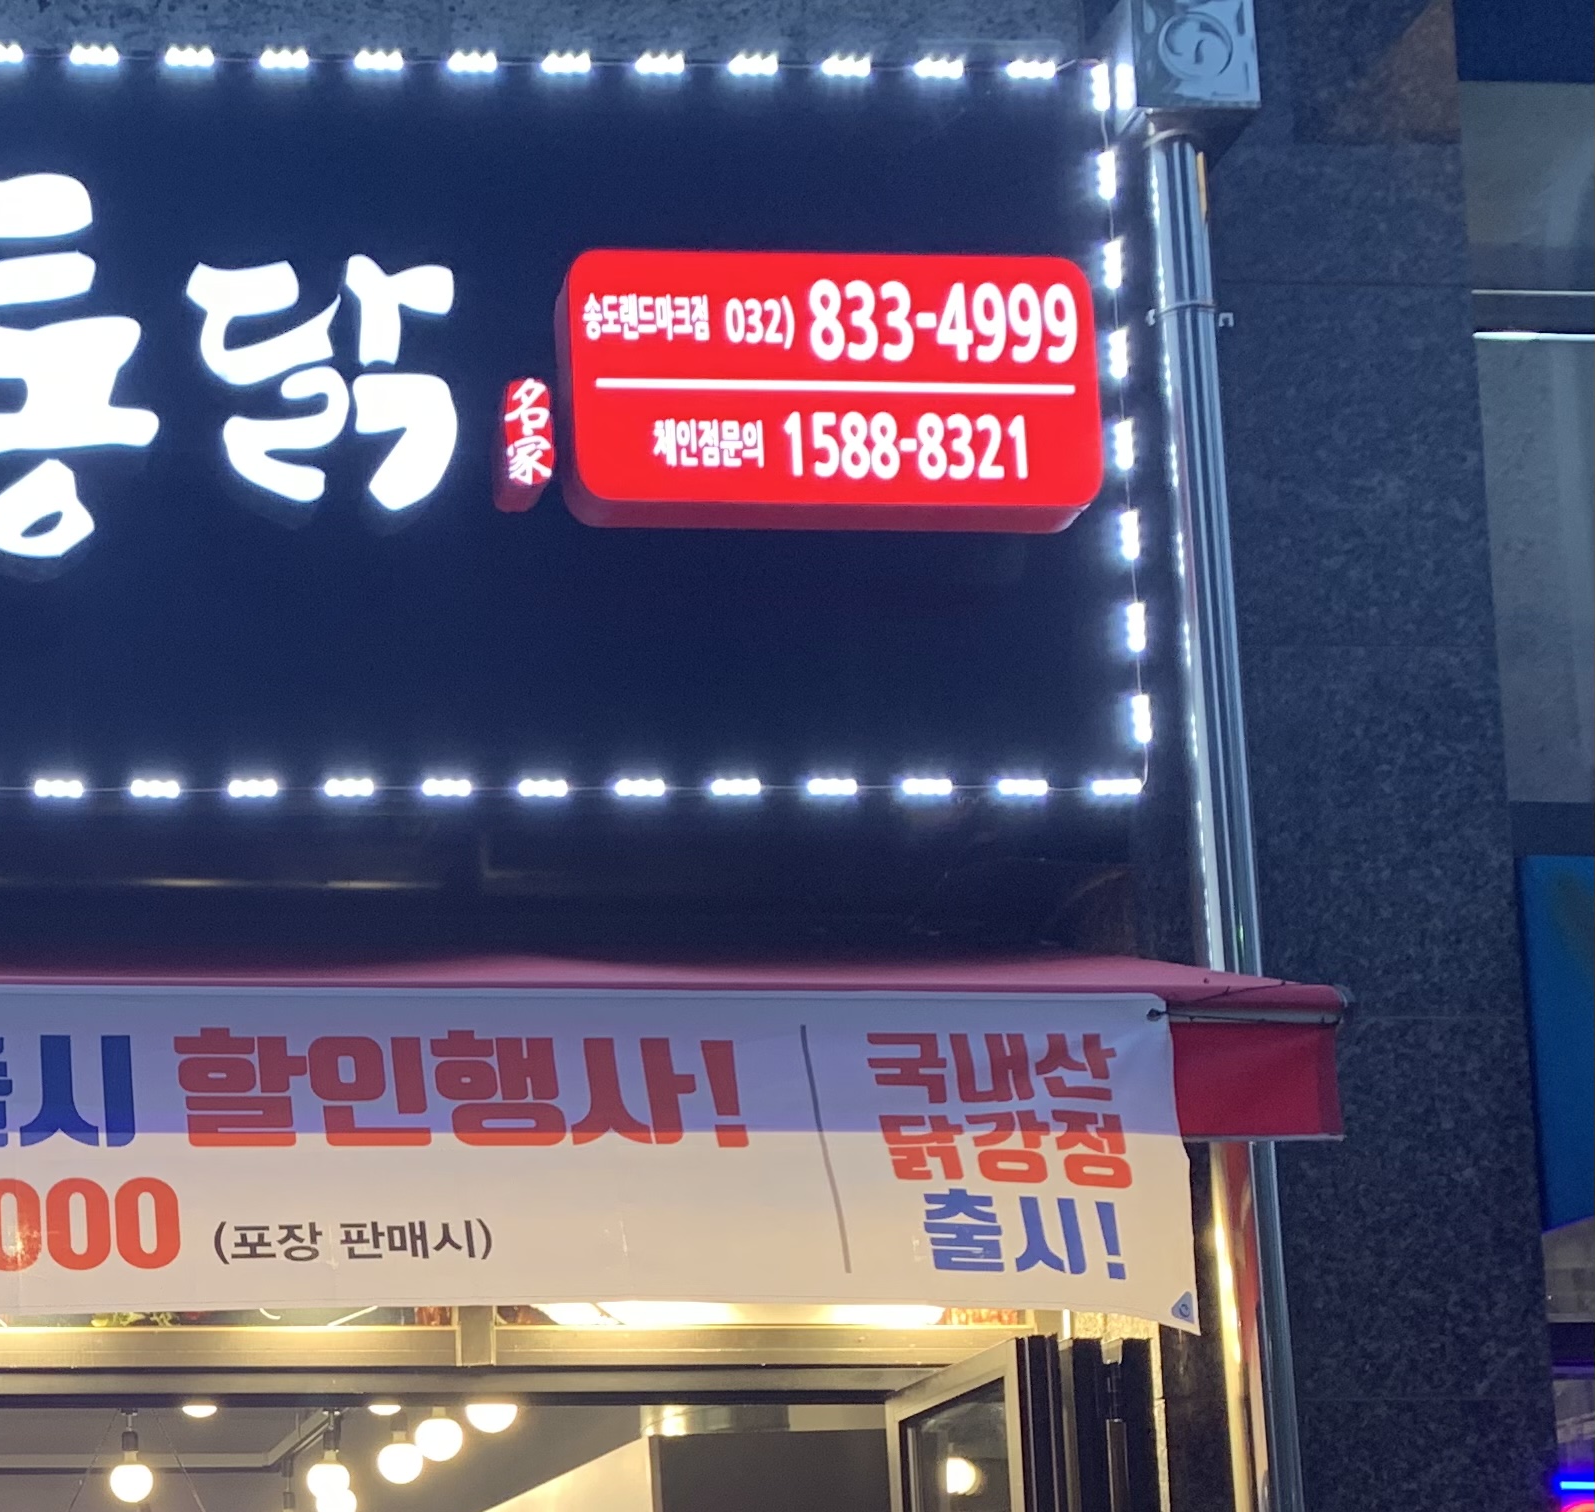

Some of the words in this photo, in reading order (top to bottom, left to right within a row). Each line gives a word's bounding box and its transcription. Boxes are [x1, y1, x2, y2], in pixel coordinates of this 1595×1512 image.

[725, 295, 795, 350] 032)
[809, 278, 1078, 365] 833-4999
[652, 417, 765, 469] 체인점문의
[784, 410, 1029, 481] 1588-8321
[173, 1026, 750, 1148] 할인행사!
[867, 1031, 1117, 1105] 국내산
[876, 1109, 1134, 1189] 닭강정
[213, 1220, 323, 1265] (포장
[338, 1217, 494, 1263] 판매시)
[923, 1188, 1128, 1280] 출시!
